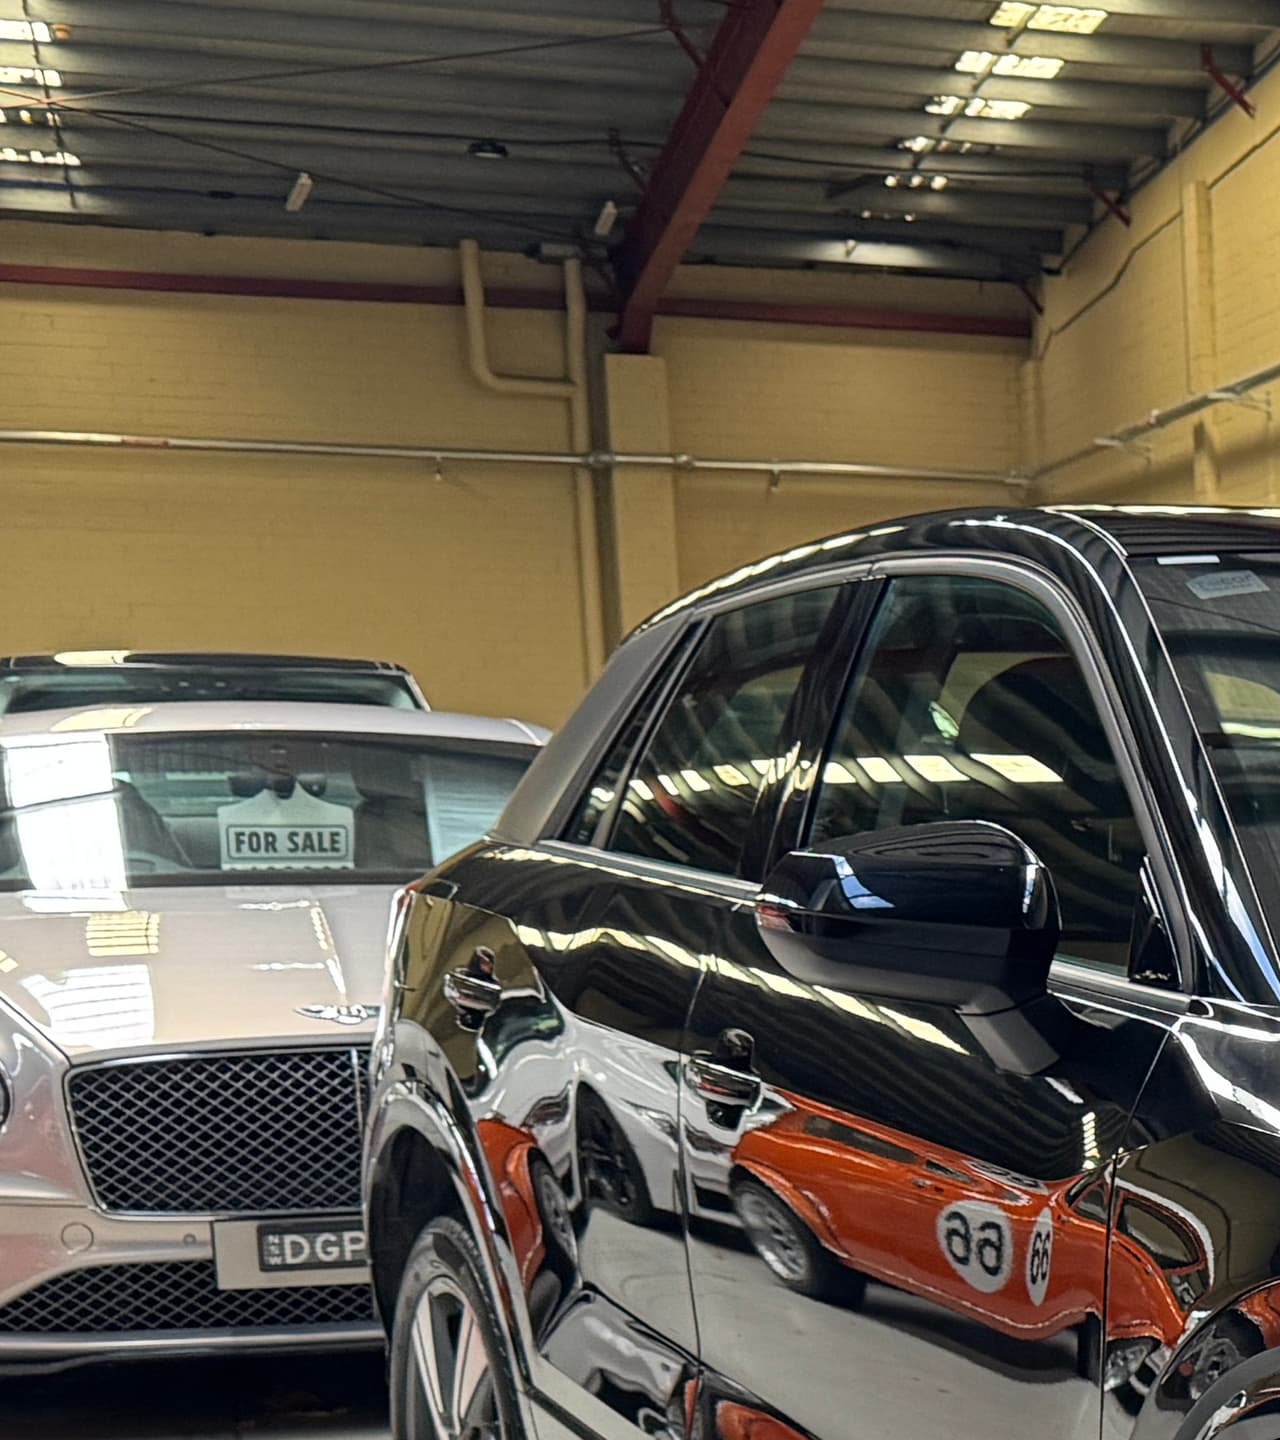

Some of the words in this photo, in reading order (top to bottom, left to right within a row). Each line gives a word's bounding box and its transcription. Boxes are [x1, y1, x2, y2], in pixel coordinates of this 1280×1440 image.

[234, 831, 278, 853] FOR
[287, 831, 341, 853] SALE
[283, 1230, 367, 1264] DGP
